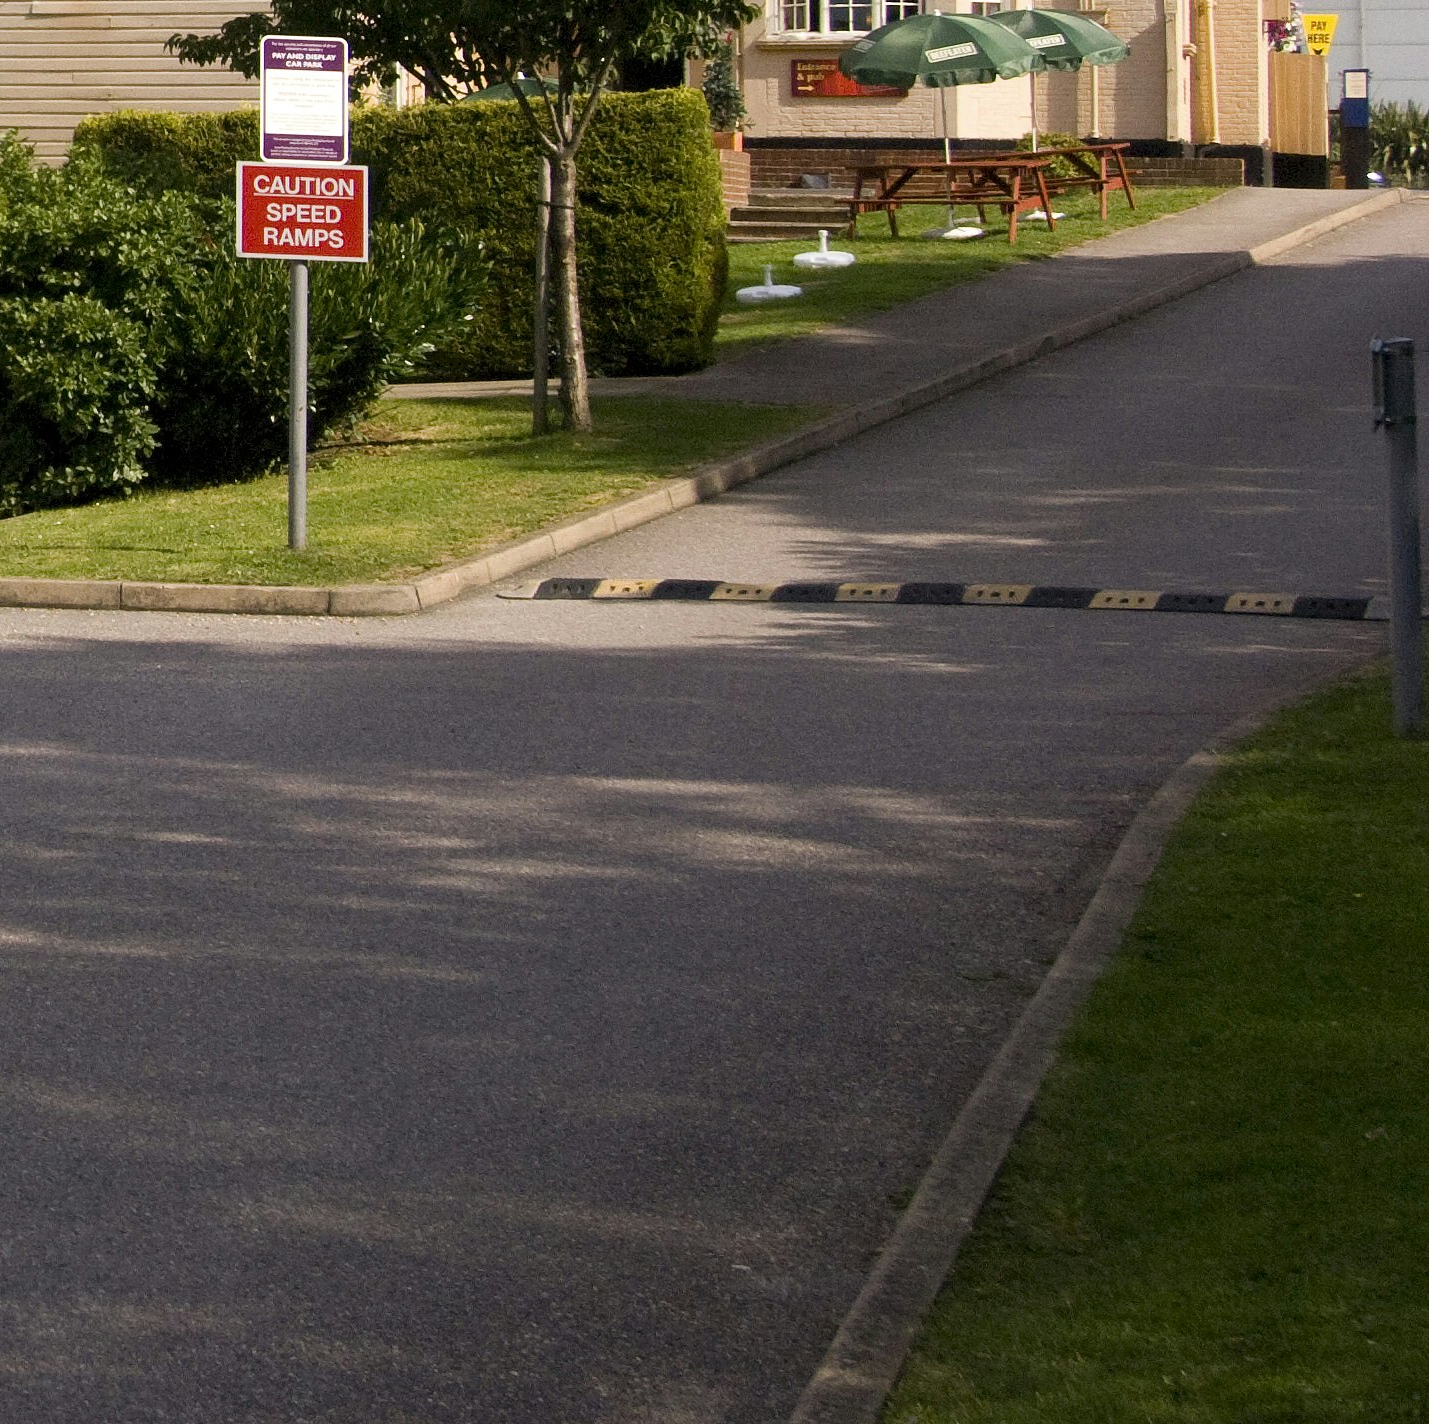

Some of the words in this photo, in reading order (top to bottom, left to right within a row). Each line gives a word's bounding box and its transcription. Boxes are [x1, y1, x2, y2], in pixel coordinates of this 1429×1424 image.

[1310, 21, 1327, 31] PAY
[1307, 33, 1330, 44] HERE
[271, 52, 286, 60] PAY
[286, 52, 304, 60] AND
[305, 53, 337, 61] DISPLAY
[253, 174, 355, 196] CAUTION
[266, 202, 342, 224] SPEED
[263, 226, 344, 249] RAMPS
